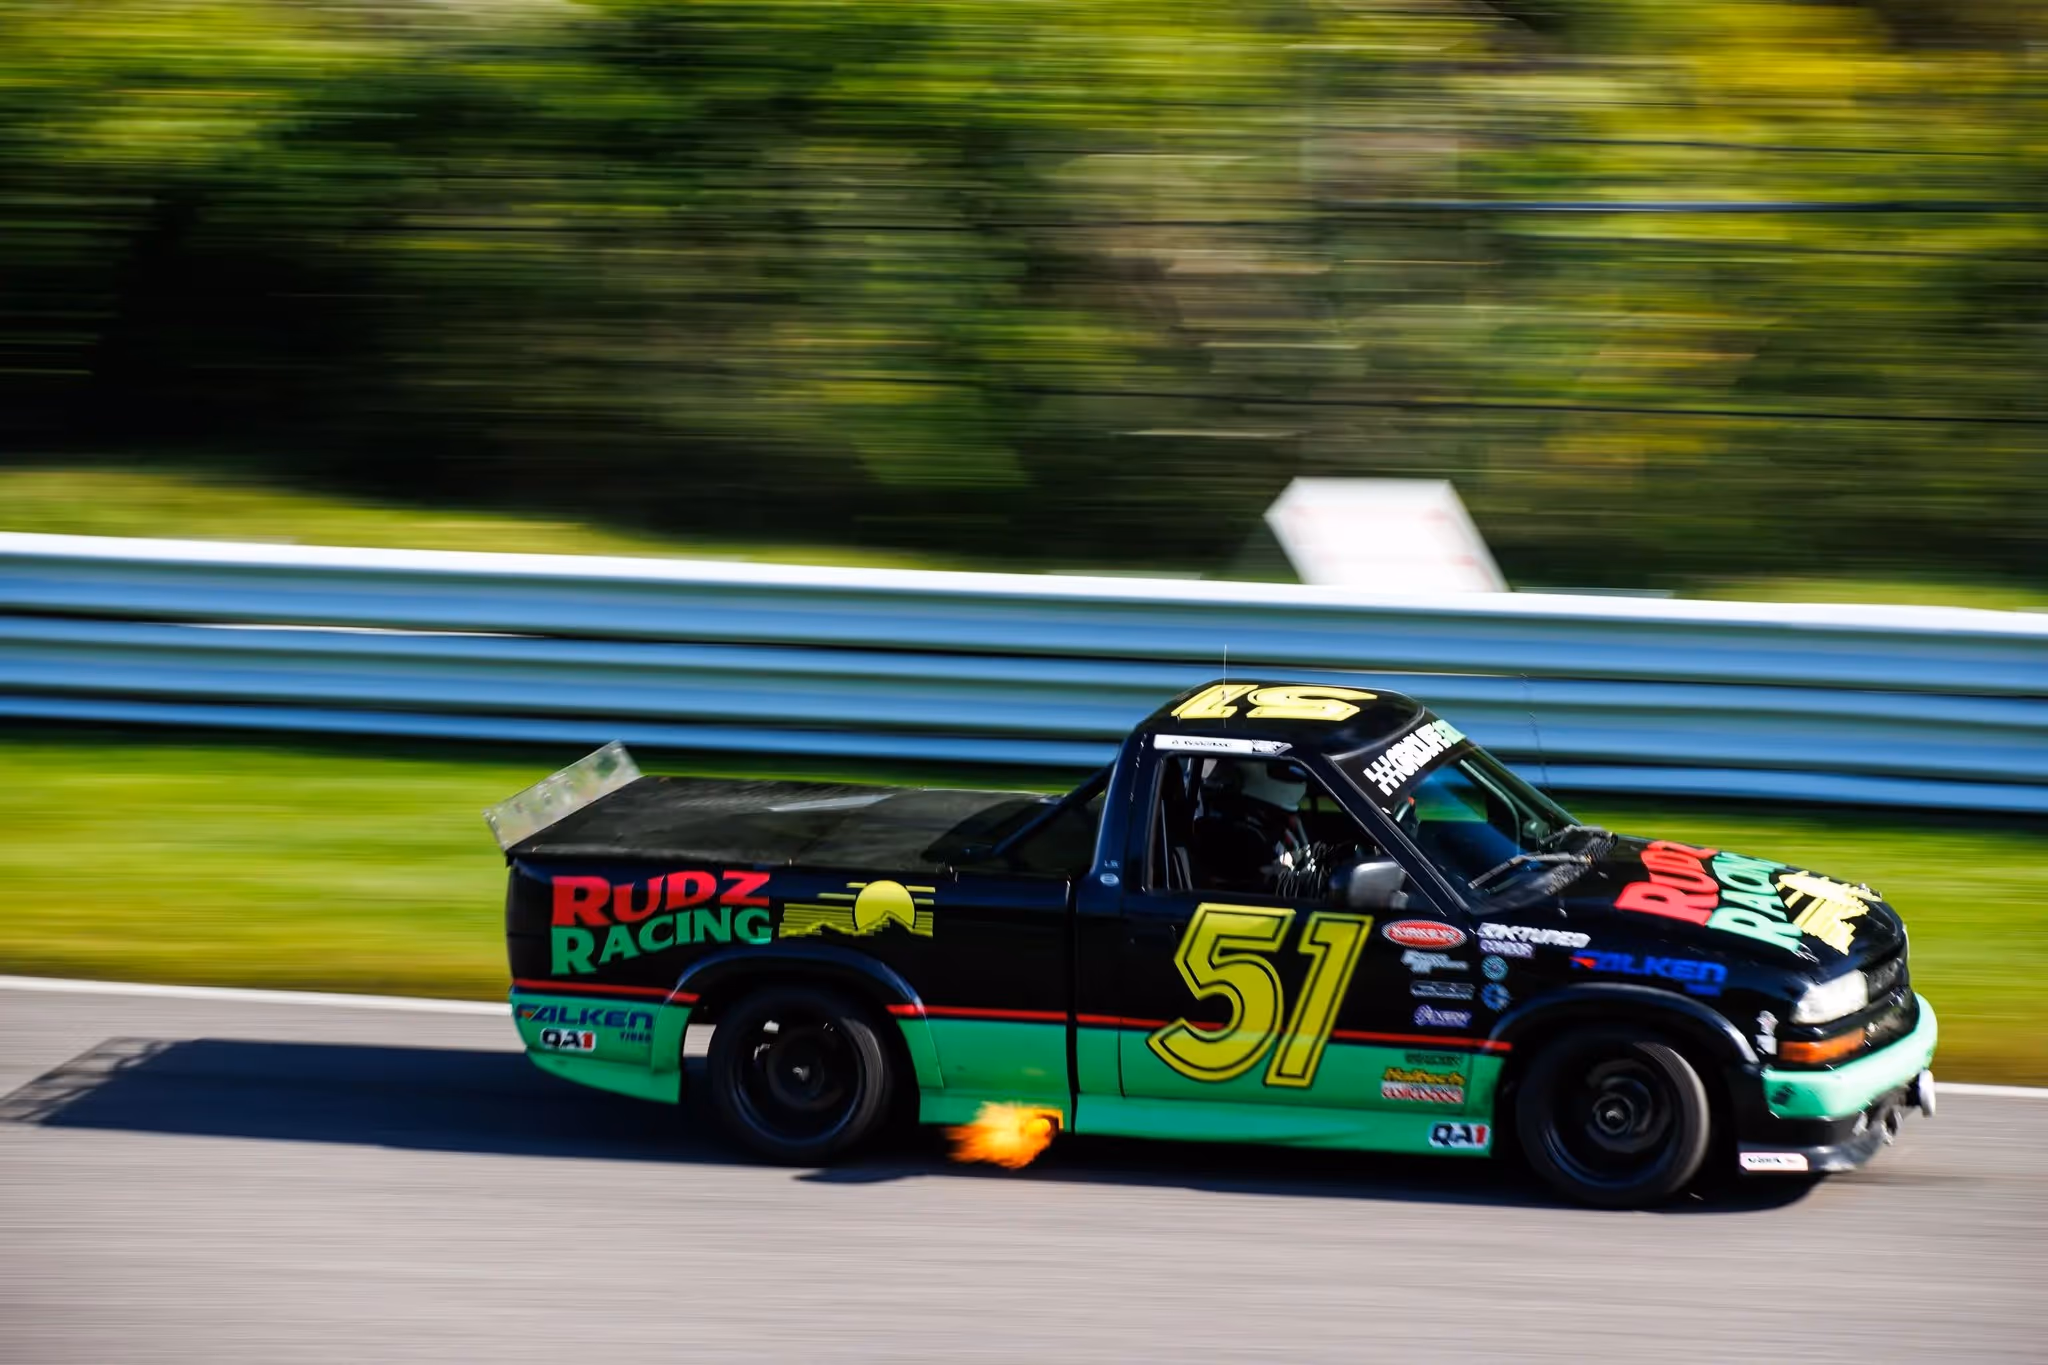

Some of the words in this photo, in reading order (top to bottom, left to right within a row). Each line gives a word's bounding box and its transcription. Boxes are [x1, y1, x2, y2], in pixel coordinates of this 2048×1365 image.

[1170, 684, 1378, 721] 51
[551, 870, 770, 926] RUDZ
[551, 907, 773, 975] RACING
[1569, 950, 1728, 983] FALKEN
[1146, 901, 1374, 1088] 51
[516, 1003, 653, 1029] FALKEN
[541, 1028, 594, 1049] QA1
[1431, 1123, 1486, 1146] QA1
